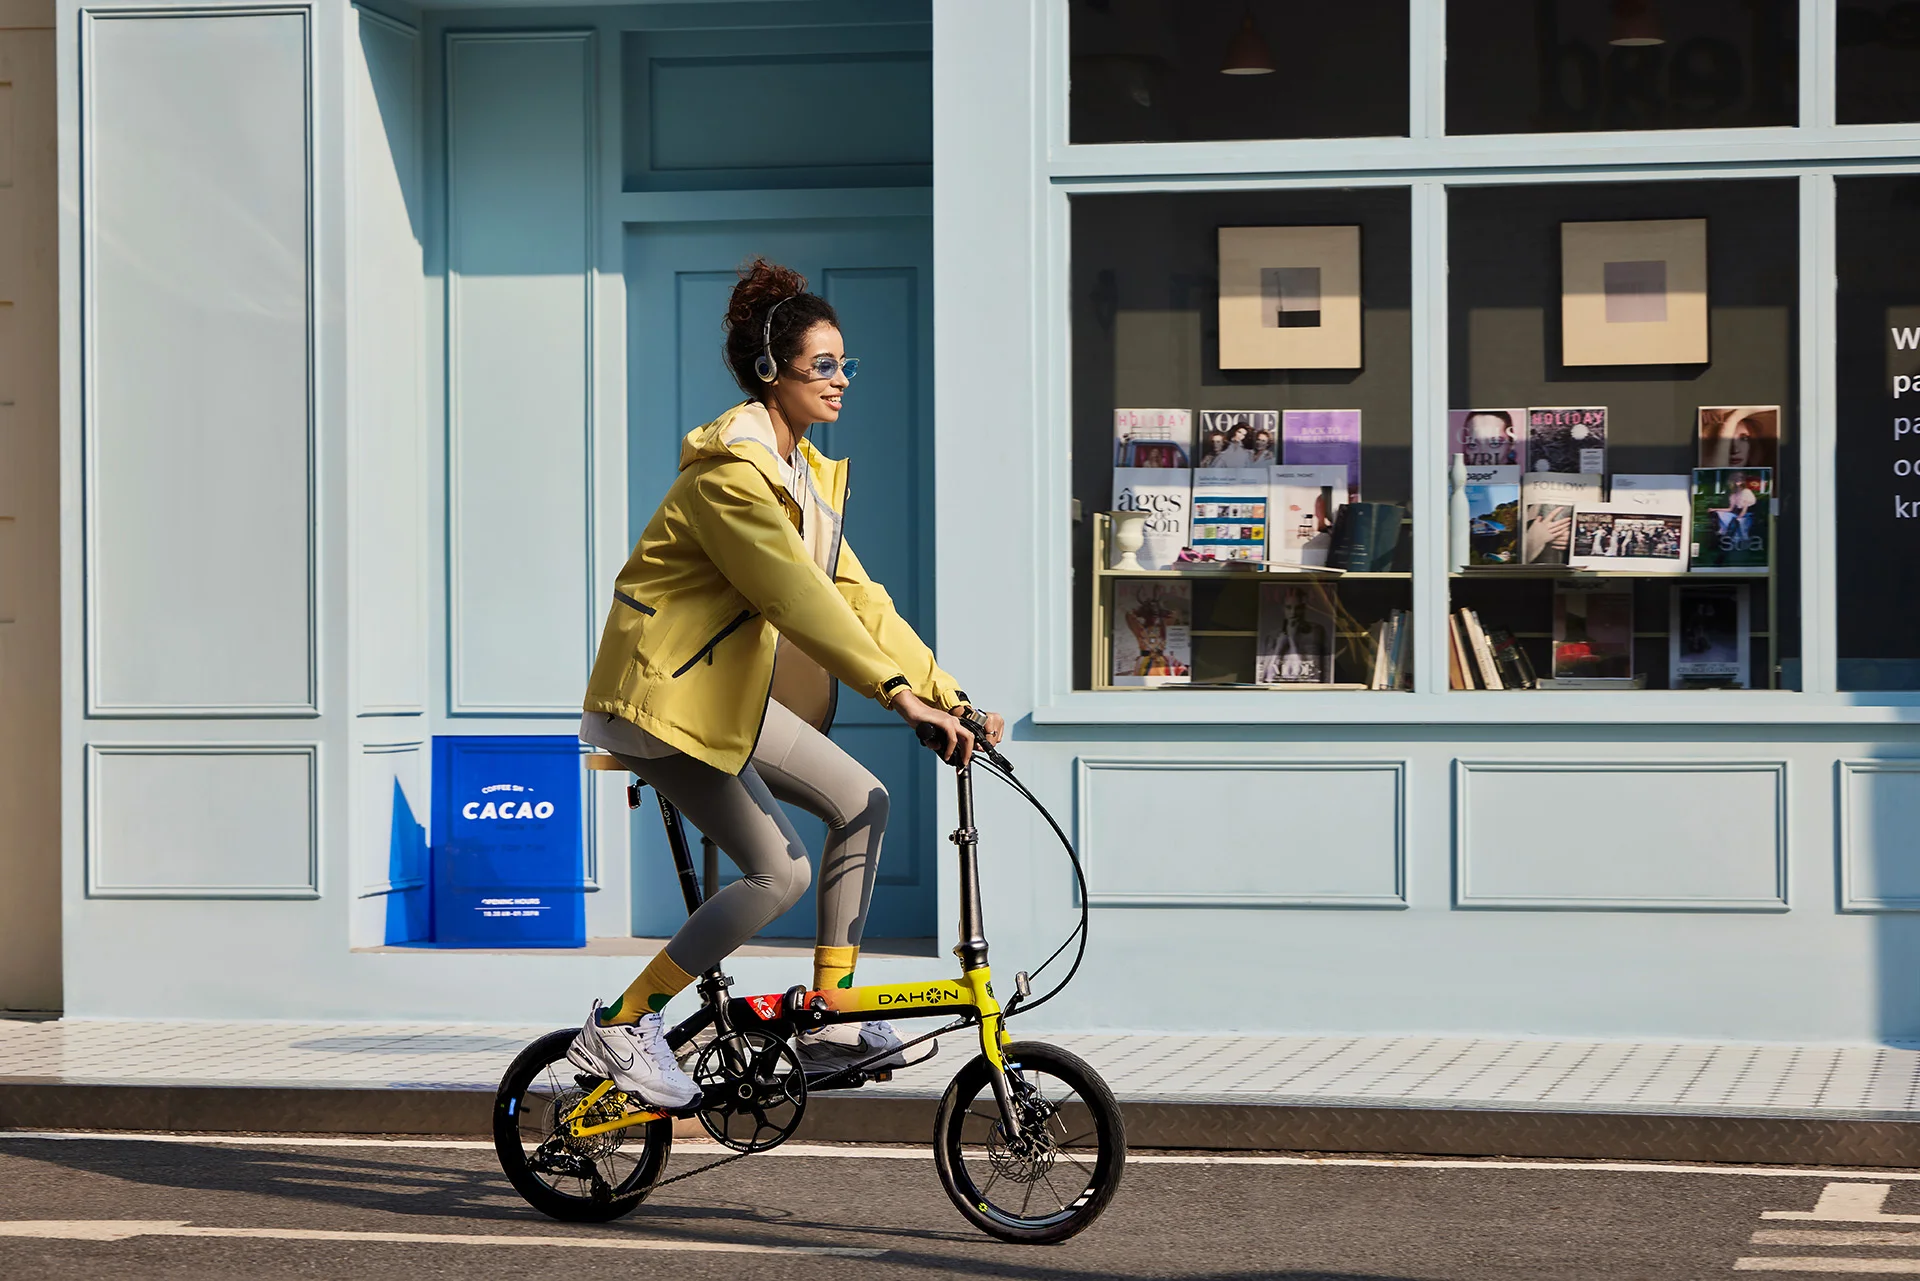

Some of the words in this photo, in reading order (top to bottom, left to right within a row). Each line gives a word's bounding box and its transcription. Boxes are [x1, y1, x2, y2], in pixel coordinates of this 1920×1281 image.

[1531, 413, 1603, 425] HOLIDAY
[1533, 480, 1587, 491] FOLLOW
[462, 801, 555, 820] CACAO
[878, 987, 959, 1005] DAHON
